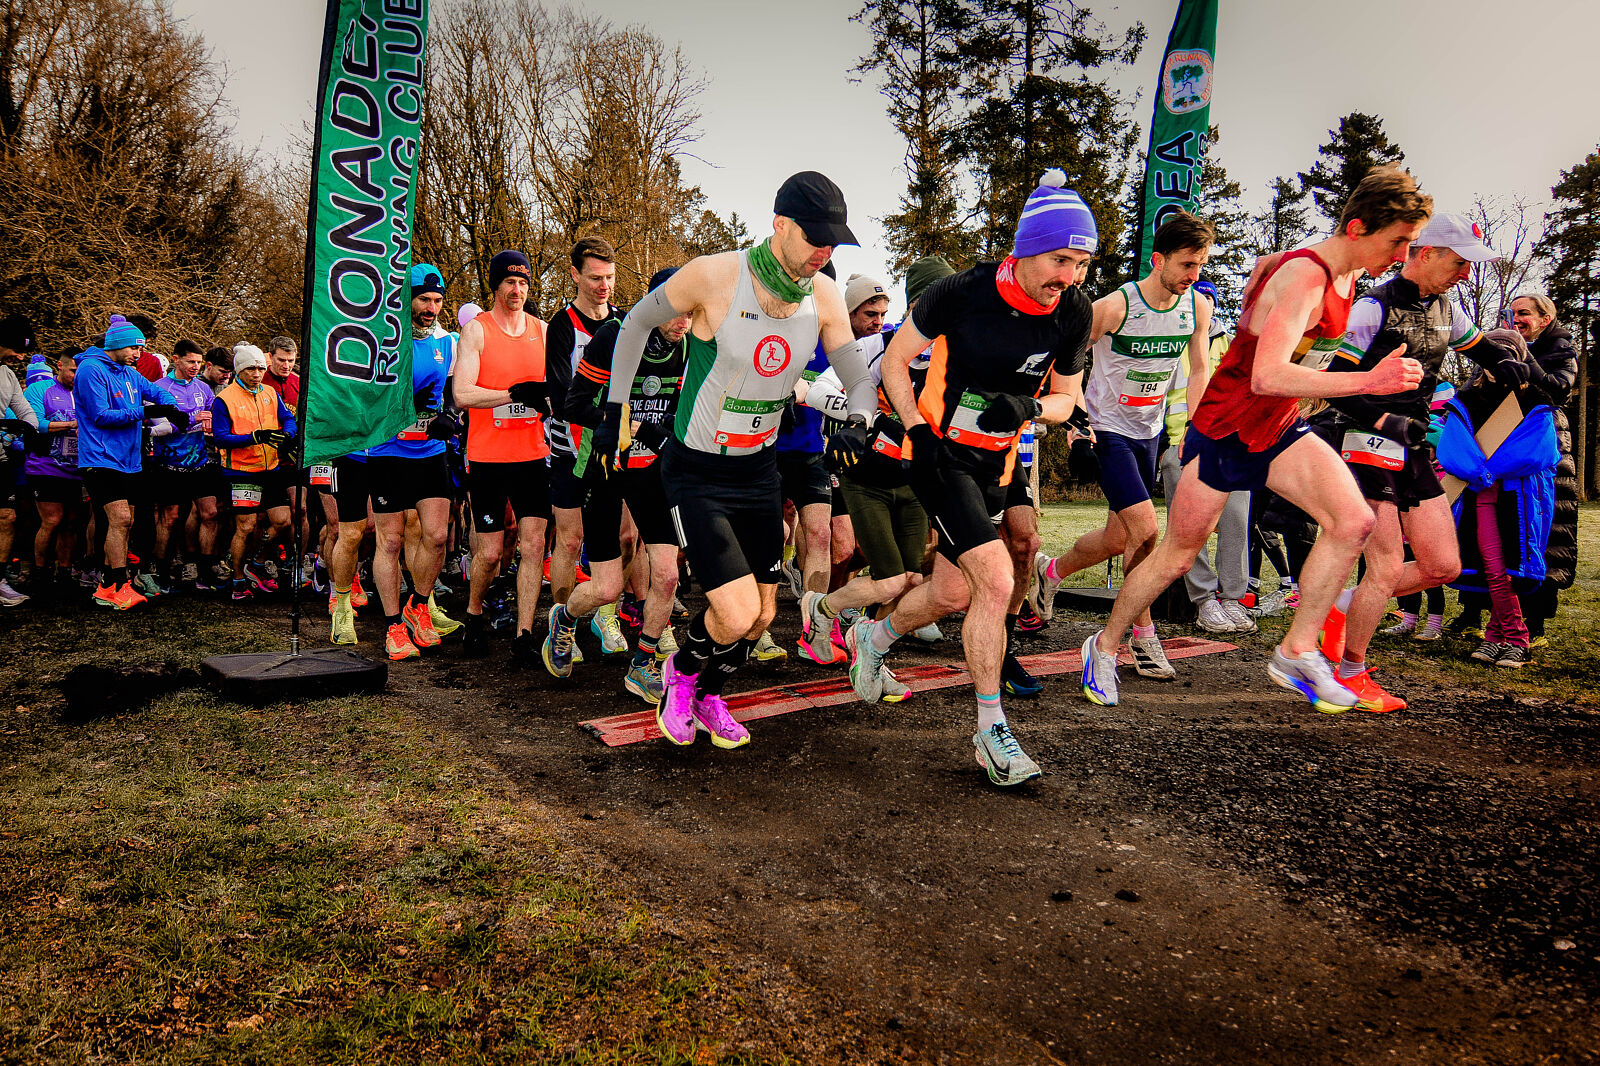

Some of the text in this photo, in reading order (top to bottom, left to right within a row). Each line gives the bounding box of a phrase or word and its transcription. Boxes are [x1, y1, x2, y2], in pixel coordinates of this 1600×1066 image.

[324, 0, 388, 383] DONADE
[1131, 340, 1187, 354] RAHENY
[1140, 383, 1158, 393] 194
[508, 404, 526, 414] 189
[726, 400, 769, 412] donadea
[752, 416, 762, 429] 6
[1367, 437, 1384, 450] 47
[315, 466, 329, 474] 256
[244, 490, 252, 498] 21
